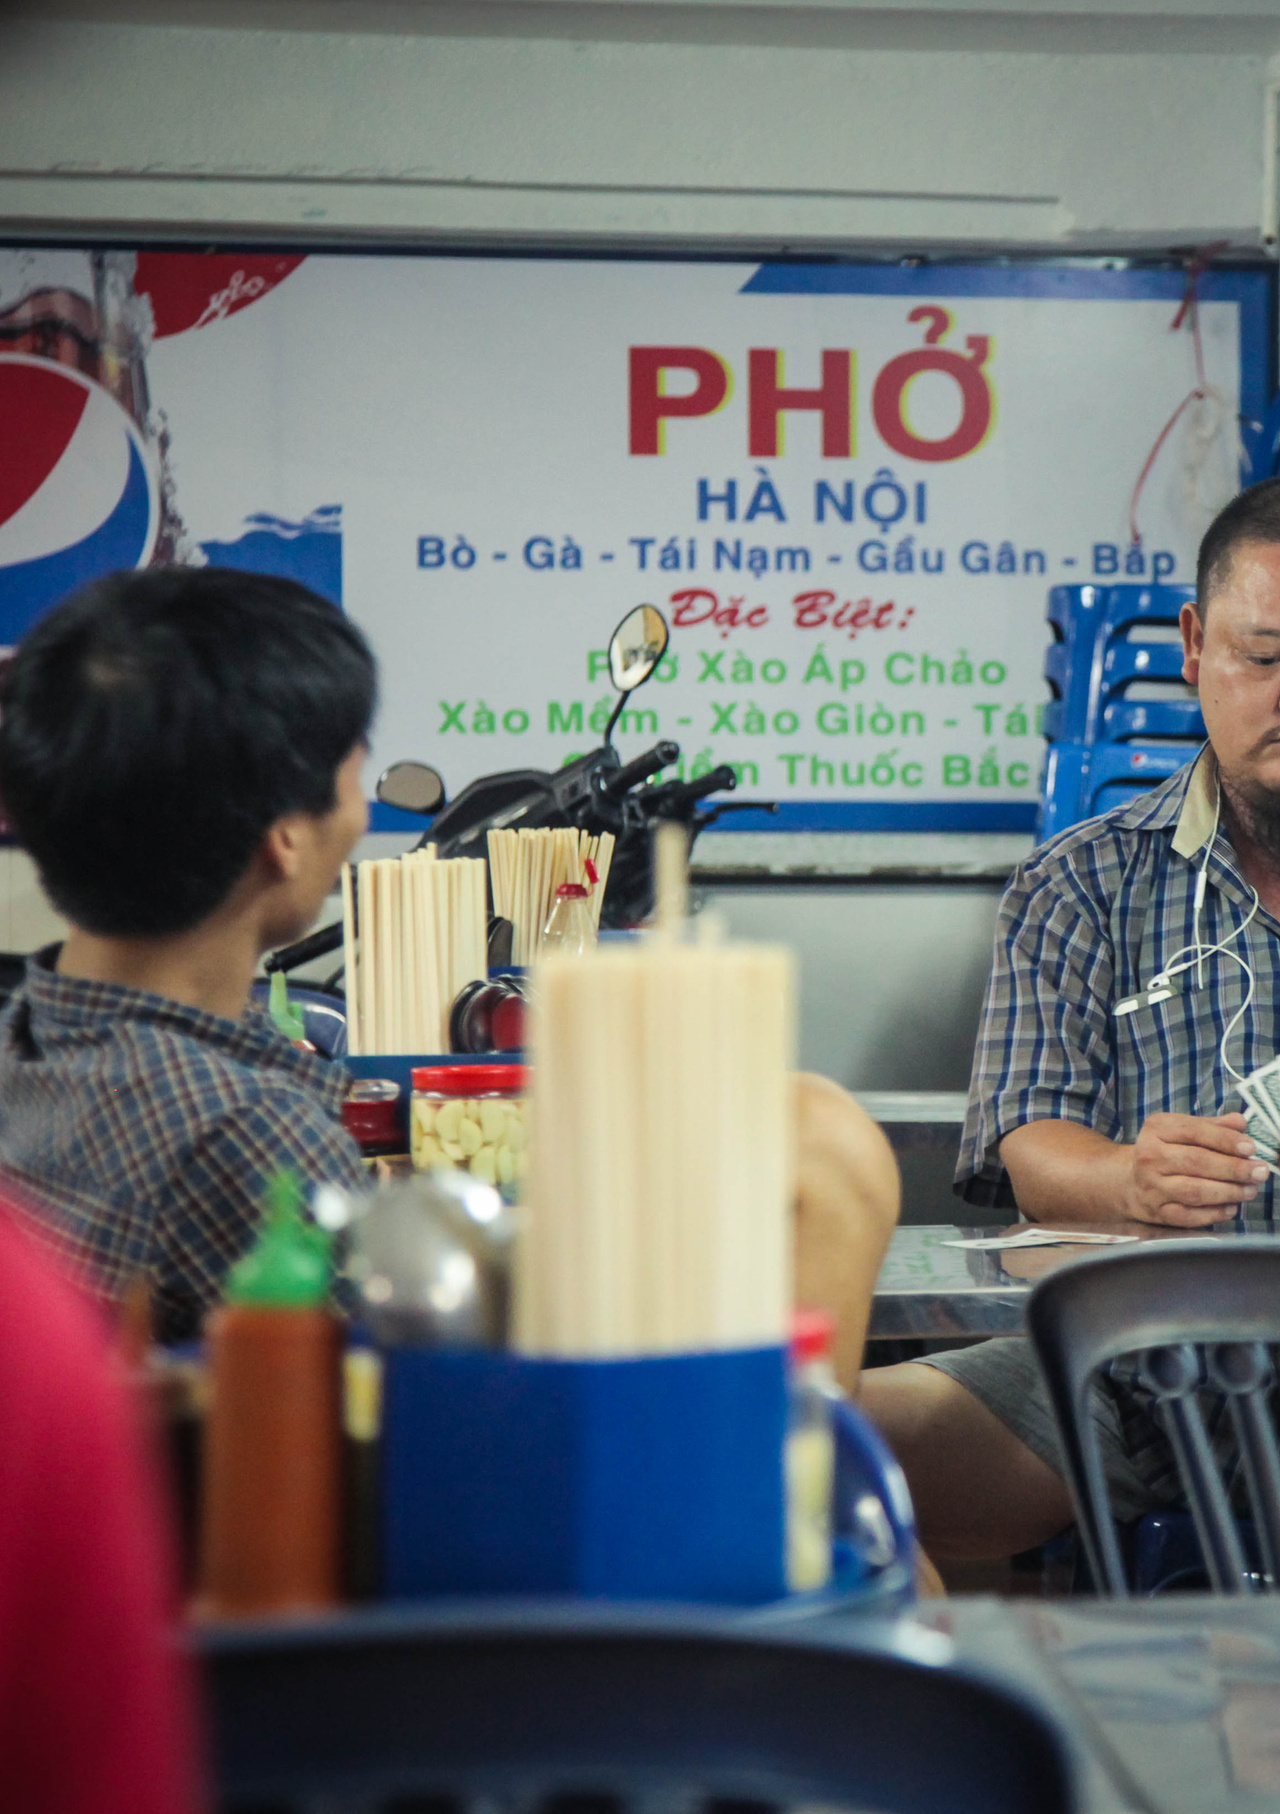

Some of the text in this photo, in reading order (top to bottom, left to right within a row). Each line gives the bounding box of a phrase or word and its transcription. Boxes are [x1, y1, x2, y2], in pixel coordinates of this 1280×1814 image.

[627, 304, 999, 463] PHỞ
[695, 466, 929, 534] HÀ NỘI
[416, 534, 479, 571] Bò
[522, 535, 585, 572] Gà
[629, 535, 698, 573] Tái
[713, 537, 813, 581] Nạm
[959, 540, 1049, 577] Gân
[668, 587, 916, 641] Đặc Biệt:
[586, 642, 1008, 693] Pở Xào Áp Chảo
[437, 698, 531, 735] Xào
[709, 700, 801, 736] Xào
[815, 701, 926, 737] Giòn
[776, 748, 924, 788] Thuốc
[941, 746, 1031, 788] Bắc
